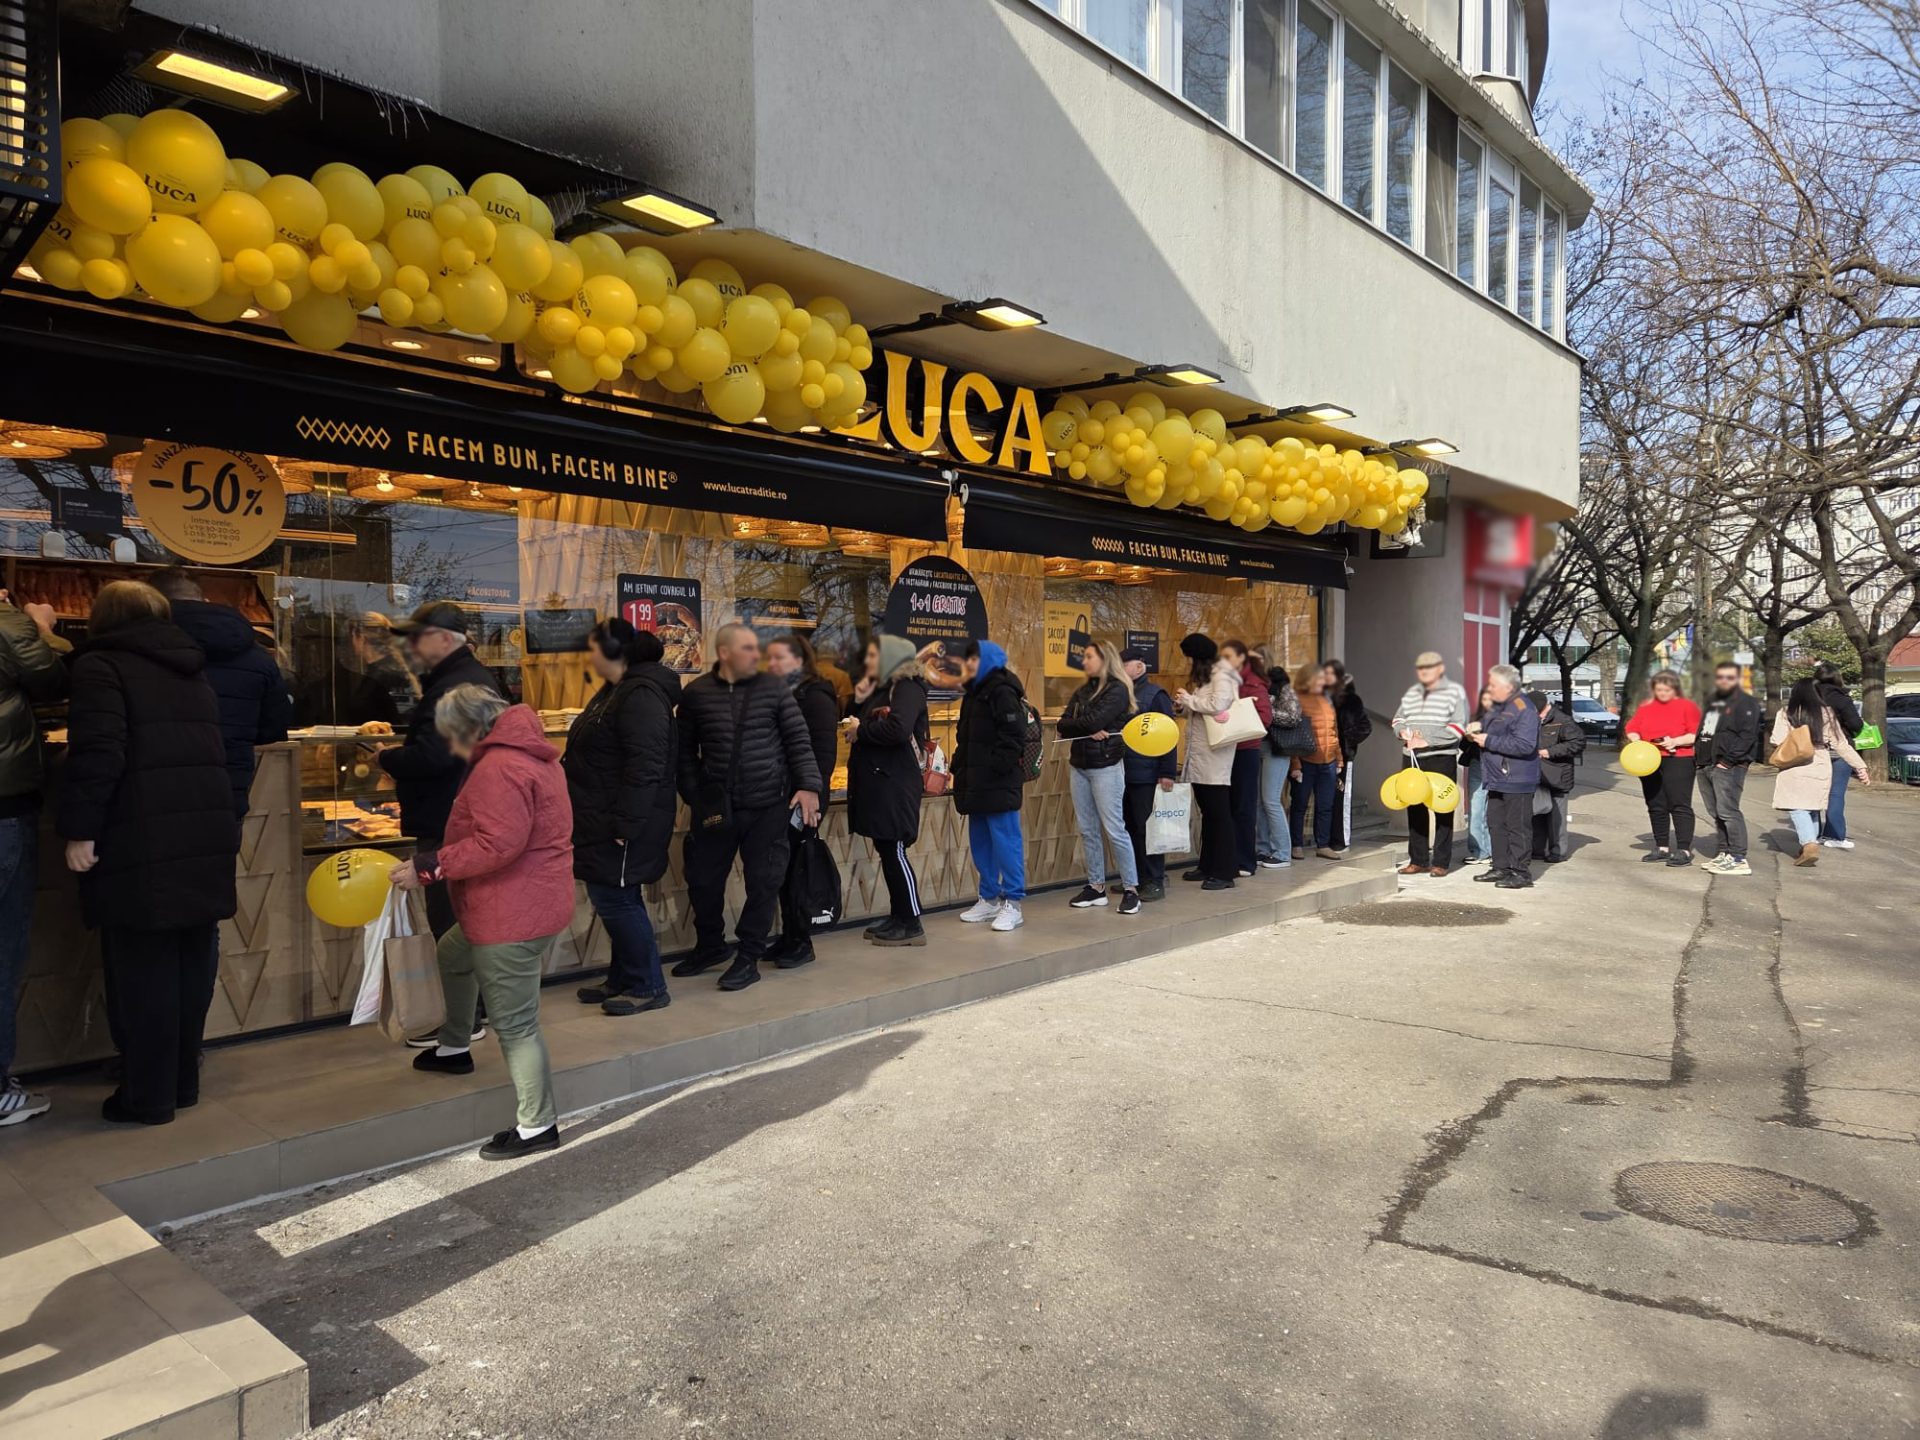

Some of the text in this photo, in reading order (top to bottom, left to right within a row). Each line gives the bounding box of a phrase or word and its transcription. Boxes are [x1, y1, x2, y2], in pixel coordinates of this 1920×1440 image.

[143, 172, 197, 203] LUCA
[486, 201, 521, 222] LUCA
[718, 284, 744, 297] UCA
[724, 363, 748, 376] LUC
[407, 431, 485, 464] FACEM
[494, 444, 547, 475] BUN,
[552, 453, 616, 483] FACEM
[149, 460, 263, 517] -50%
[703, 481, 787, 500] www.lucatraditie.ro
[1128, 541, 1159, 557] FACEM
[1160, 545, 1181, 563] BUN,
[1181, 549, 1207, 564] FACEM
[623, 582, 633, 593] AM
[689, 587, 696, 598] LA
[910, 592, 968, 616] 1+1 GRATIS
